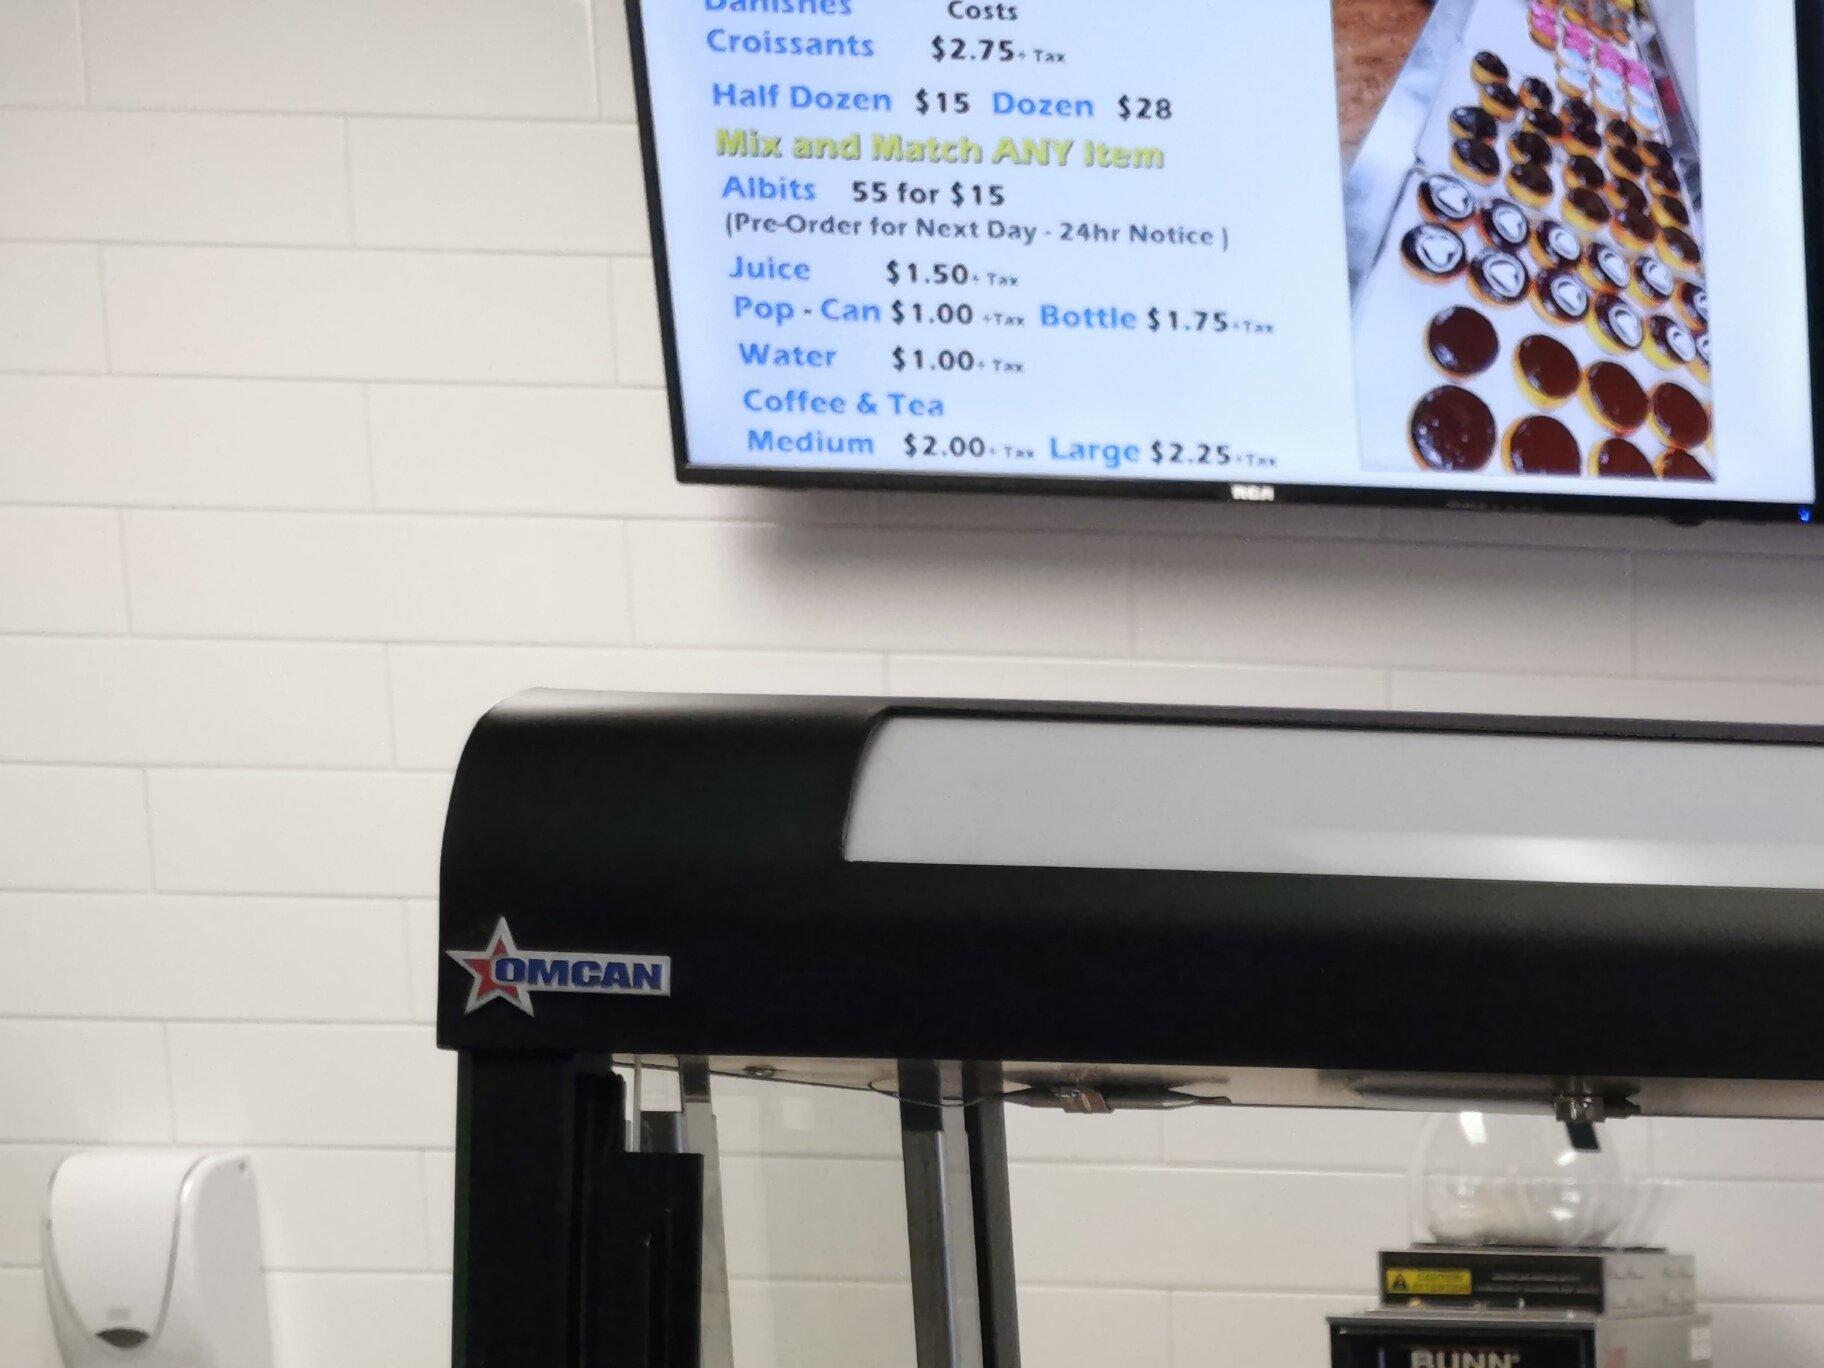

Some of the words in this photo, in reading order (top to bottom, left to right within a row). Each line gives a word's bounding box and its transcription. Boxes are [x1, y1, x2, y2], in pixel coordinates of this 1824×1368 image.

[948, 0, 1019, 21] Costs
[706, 28, 875, 57] Croissants
[711, 82, 780, 109] Half
[790, 85, 892, 112] Dozen
[915, 87, 971, 116] $15
[992, 91, 1094, 118] Dozen
[1117, 94, 1172, 121] $28
[716, 128, 783, 158] Mix
[793, 132, 861, 161] and
[871, 133, 984, 163] Match
[992, 138, 1075, 166] ANY
[1083, 139, 1166, 170] Item
[722, 174, 817, 201] Albits
[853, 180, 888, 203] 55
[898, 182, 939, 206] for
[952, 181, 1006, 208] $15
[870, 215, 908, 238] for
[915, 217, 978, 240] Next
[987, 219, 1037, 246] Day
[729, 256, 811, 281] Juice
[735, 296, 795, 328] Pop
[820, 298, 882, 323] Can
[1040, 304, 1138, 330] Bottle
[739, 342, 838, 369] Water
[743, 389, 848, 415] Coffee
[887, 392, 945, 418] Tea
[747, 430, 875, 456] Medium
[1050, 435, 1142, 470] Large
[495, 957, 664, 990] OMCAN
